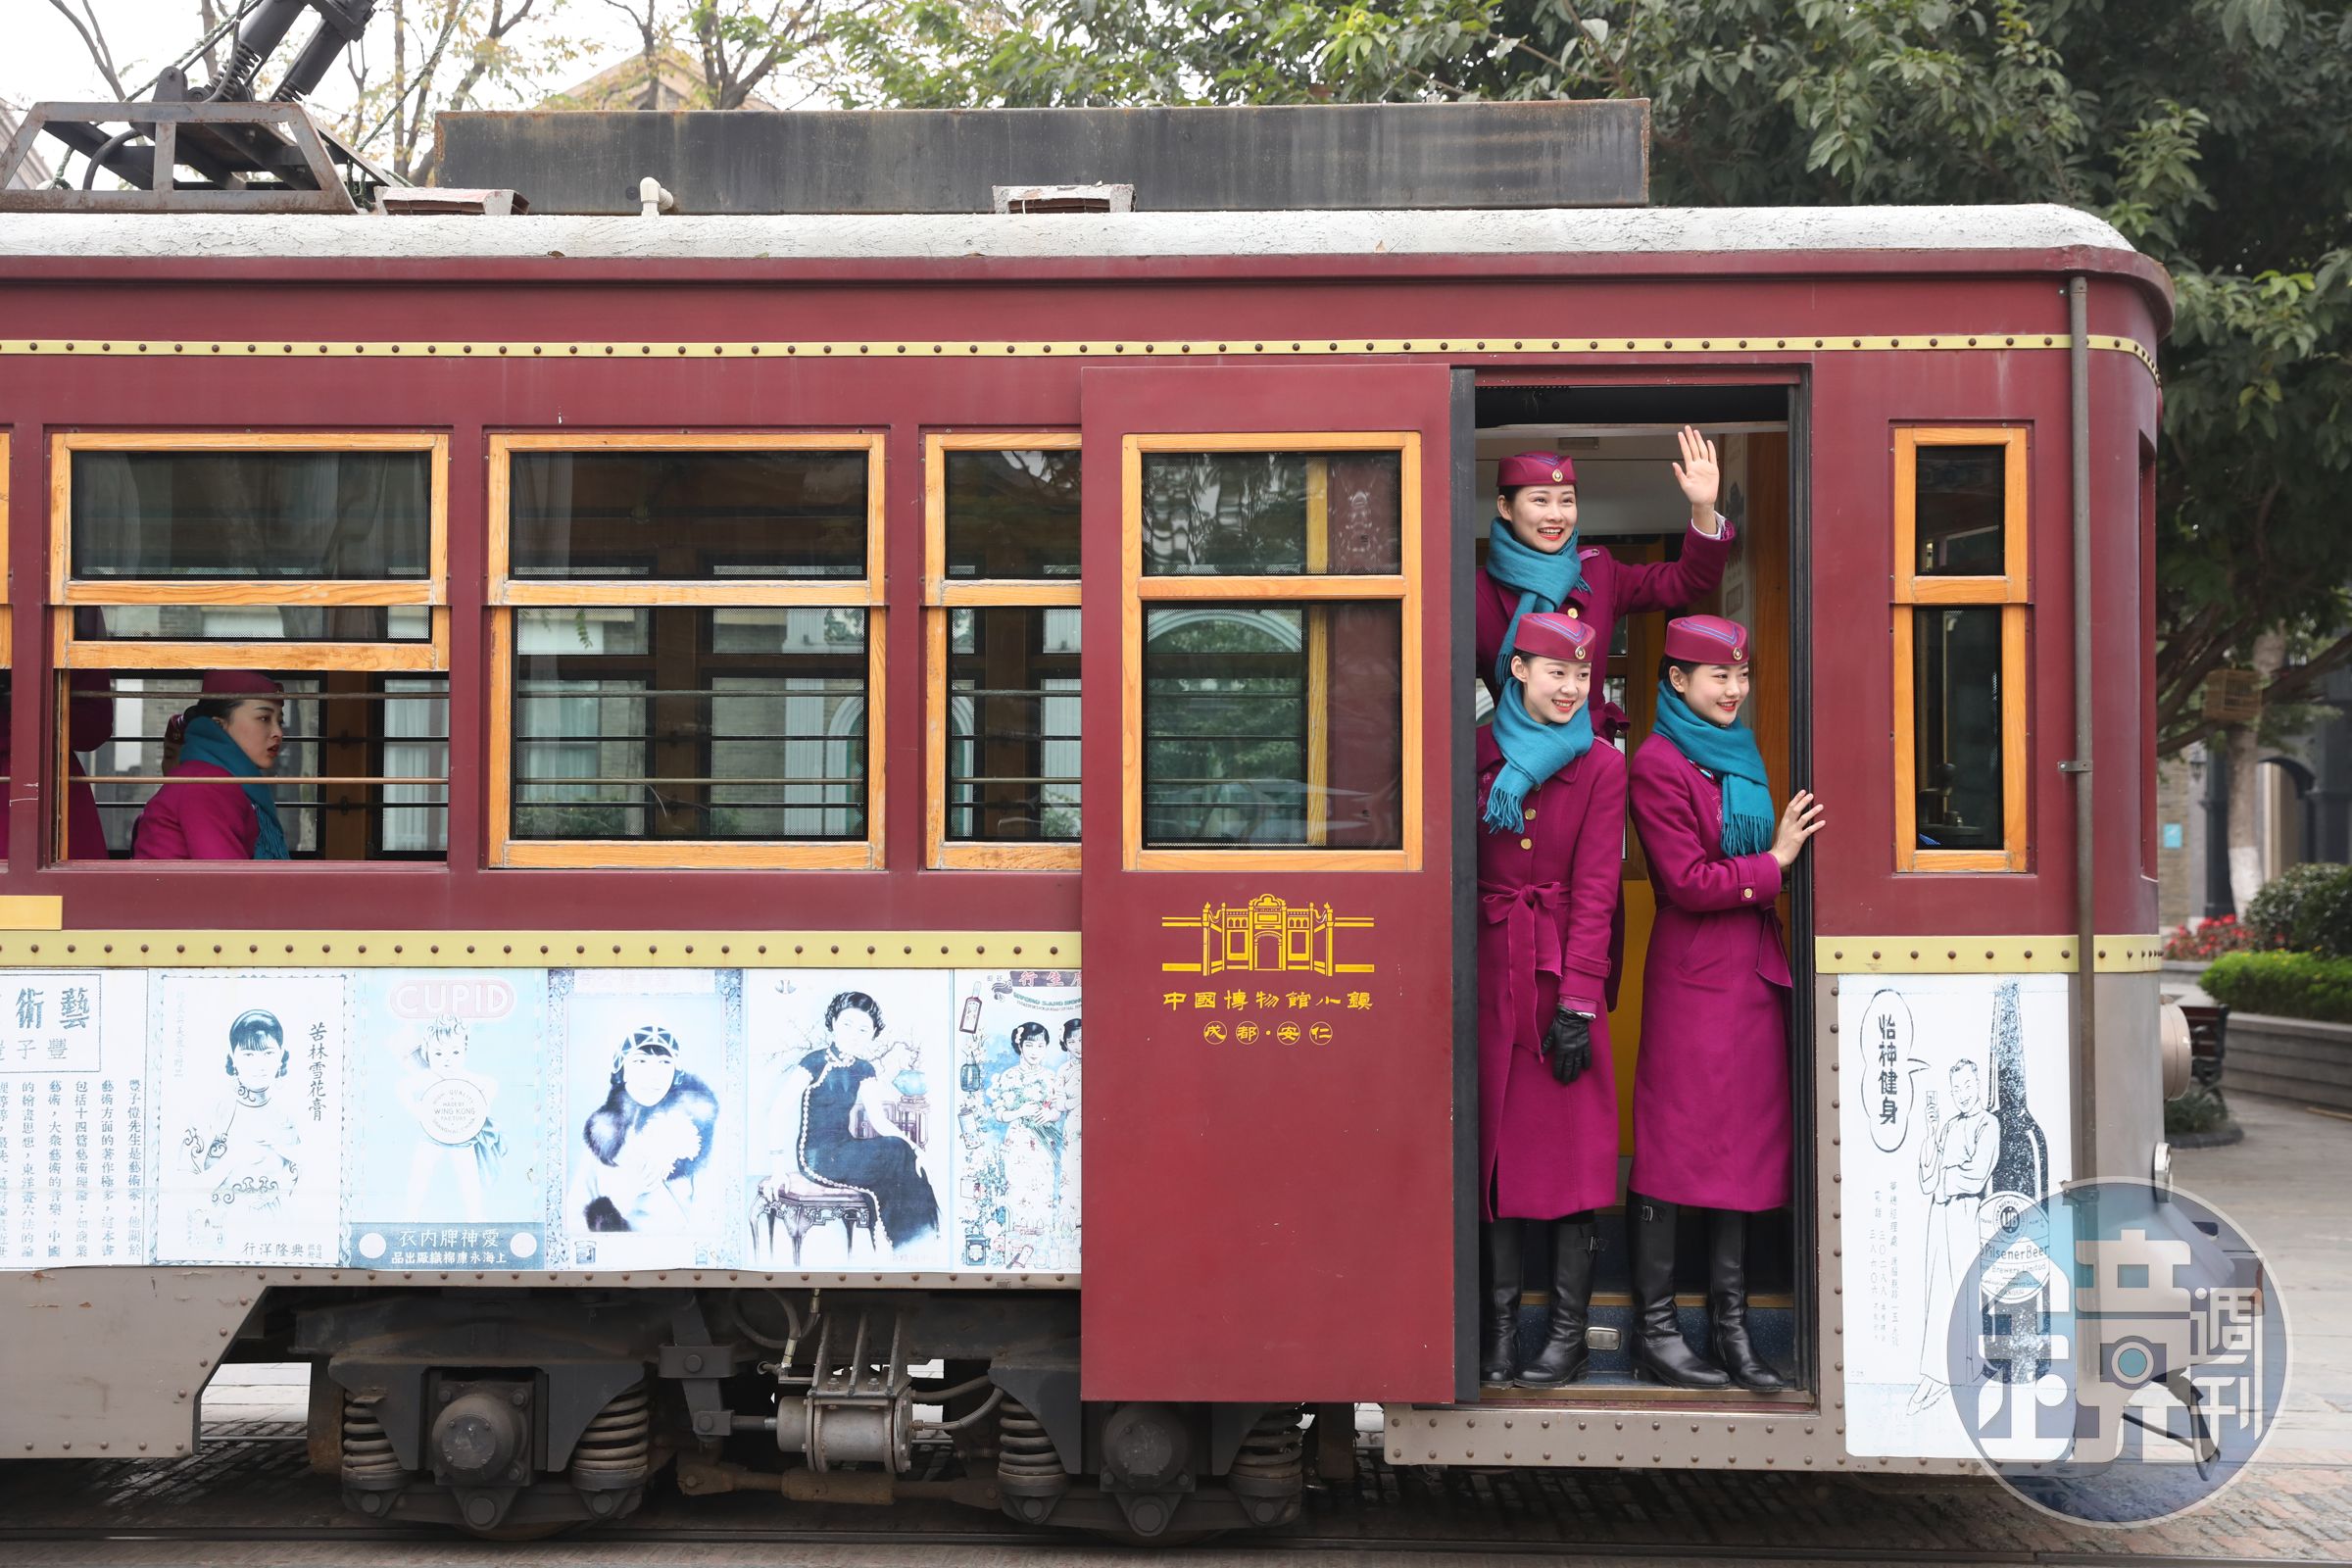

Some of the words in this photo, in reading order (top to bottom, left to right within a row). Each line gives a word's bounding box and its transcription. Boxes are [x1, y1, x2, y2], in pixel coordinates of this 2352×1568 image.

[16, 988, 90, 1030] 藝術
[396, 984, 509, 1013] CUPID
[1163, 989, 1373, 1011] 中國博物館小鎮
[0, 1039, 69, 1060] 豐子
[1878, 1013, 1898, 1125] 怡神健身
[1985, 1243, 2026, 1260] Pilsener
[2026, 1245, 2049, 1259] Beer
